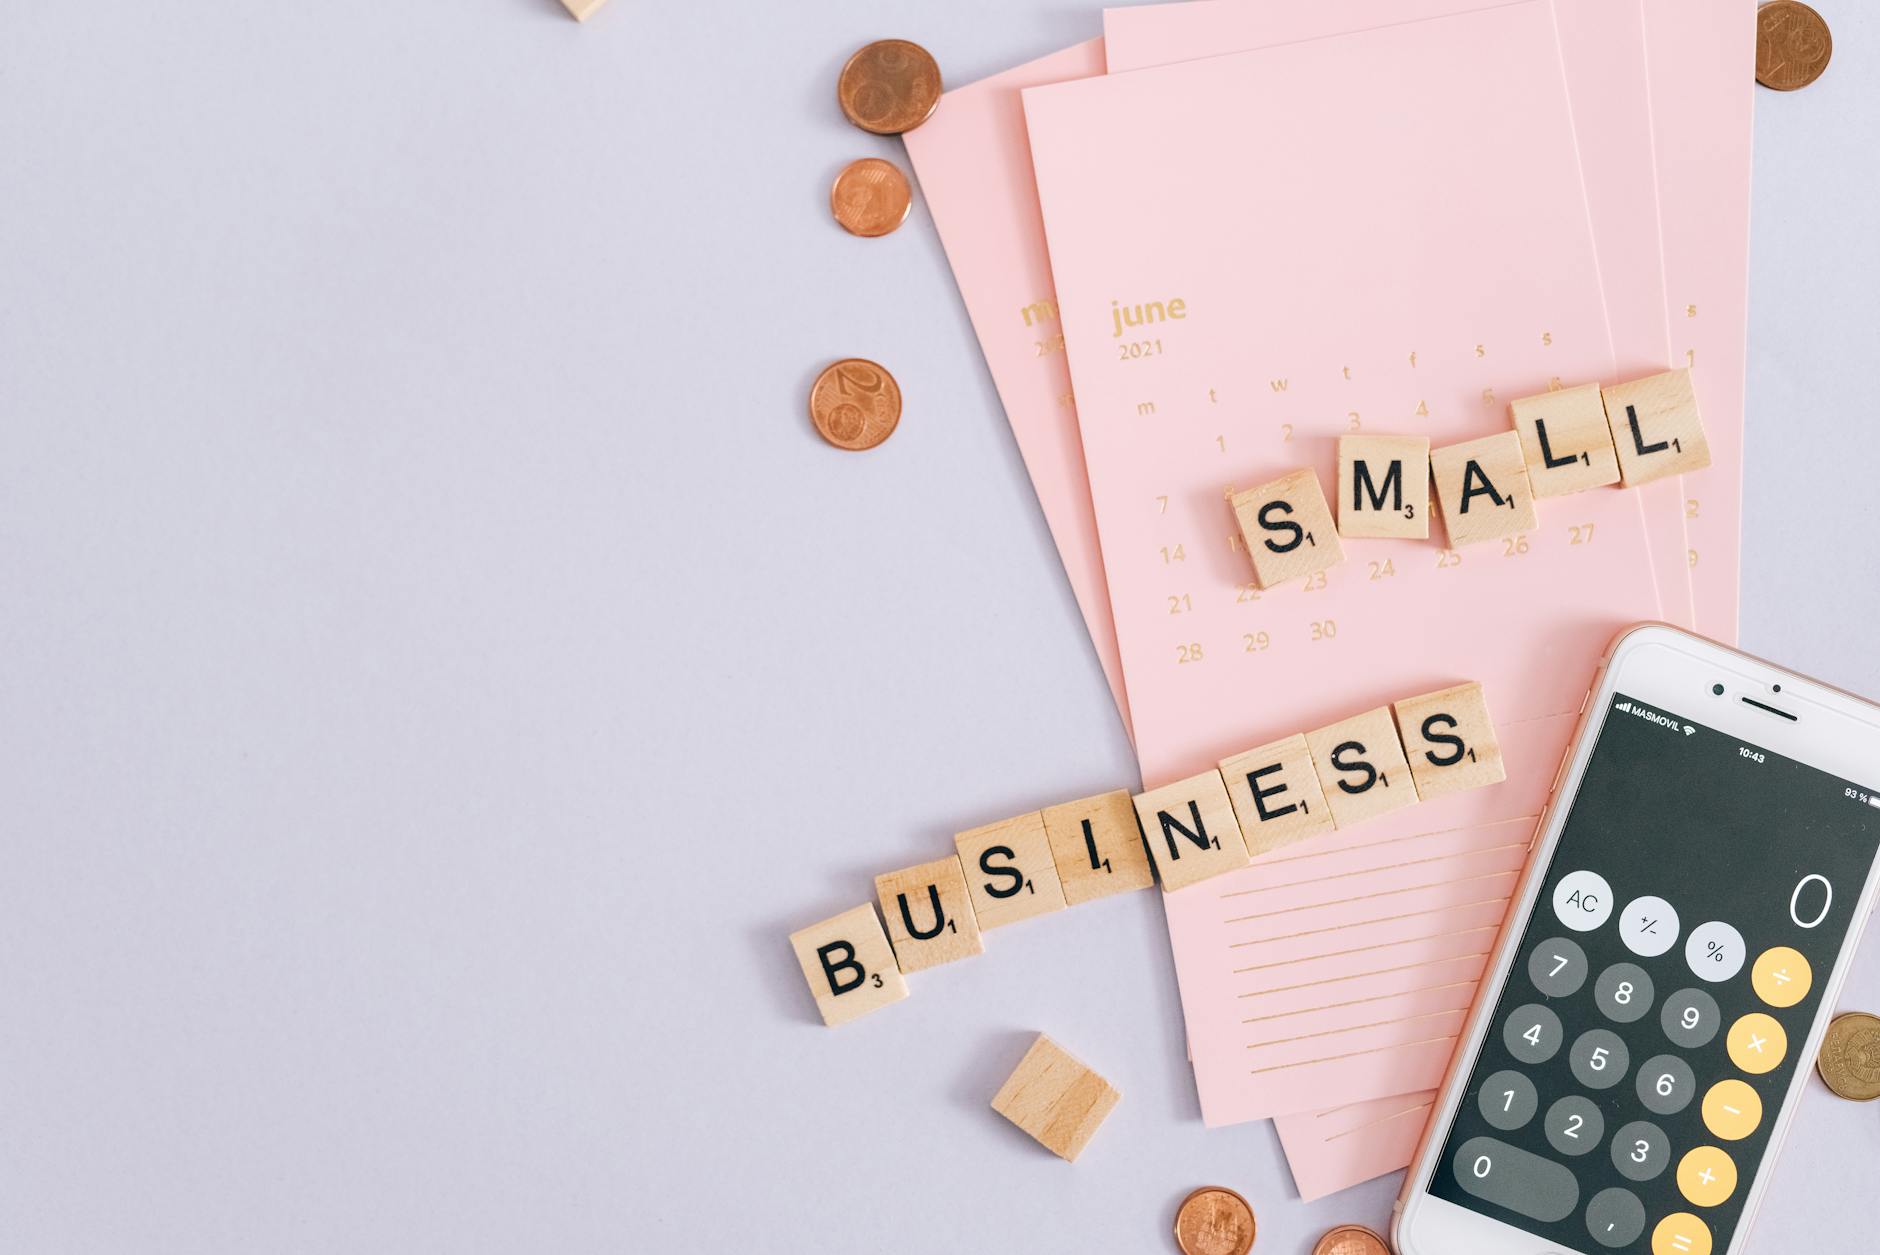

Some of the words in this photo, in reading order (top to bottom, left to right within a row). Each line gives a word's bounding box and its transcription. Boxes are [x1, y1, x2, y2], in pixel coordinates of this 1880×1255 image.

[1111, 297, 1187, 337] june
[1119, 339, 1163, 361] 2021
[1137, 401, 1156, 416] m
[1208, 387, 1218, 404] t
[1270, 378, 1288, 393] w
[1343, 365, 1353, 381] t
[1408, 351, 1418, 368] f
[1475, 344, 1486, 358] s
[1541, 332, 1553, 346] s
[1215, 435, 1226, 452] 1
[1281, 424, 1294, 442] 2
[1348, 412, 1361, 430] 3
[1416, 400, 1430, 417] 4
[1156, 495, 1168, 514] 7
[1159, 543, 1186, 564] 14
[1167, 593, 1192, 614] 21
[1234, 582, 1263, 604] 22
[1302, 570, 1328, 592] 23
[1367, 558, 1396, 581] 24
[1502, 535, 1530, 557] 26
[1567, 522, 1594, 545] 27
[1175, 643, 1204, 664] 28
[1242, 631, 1270, 653] 29
[1310, 619, 1337, 642] 30
[1630, 704, 1681, 732] MASMOVIL
[1738, 746, 1766, 764] 10:43
[1566, 888, 1599, 914] AC
[1789, 873, 1833, 929] 0
[1549, 955, 1569, 977] 7
[1613, 981, 1634, 1005] 8
[1680, 1007, 1700, 1030] 9
[1522, 1023, 1542, 1047] 4
[1589, 1047, 1610, 1071] 5
[1656, 1073, 1675, 1097] 6
[1502, 1089, 1515, 1112] 1
[1564, 1114, 1584, 1139] 2
[1630, 1140, 1650, 1163] 3
[1473, 1155, 1492, 1178] 0
